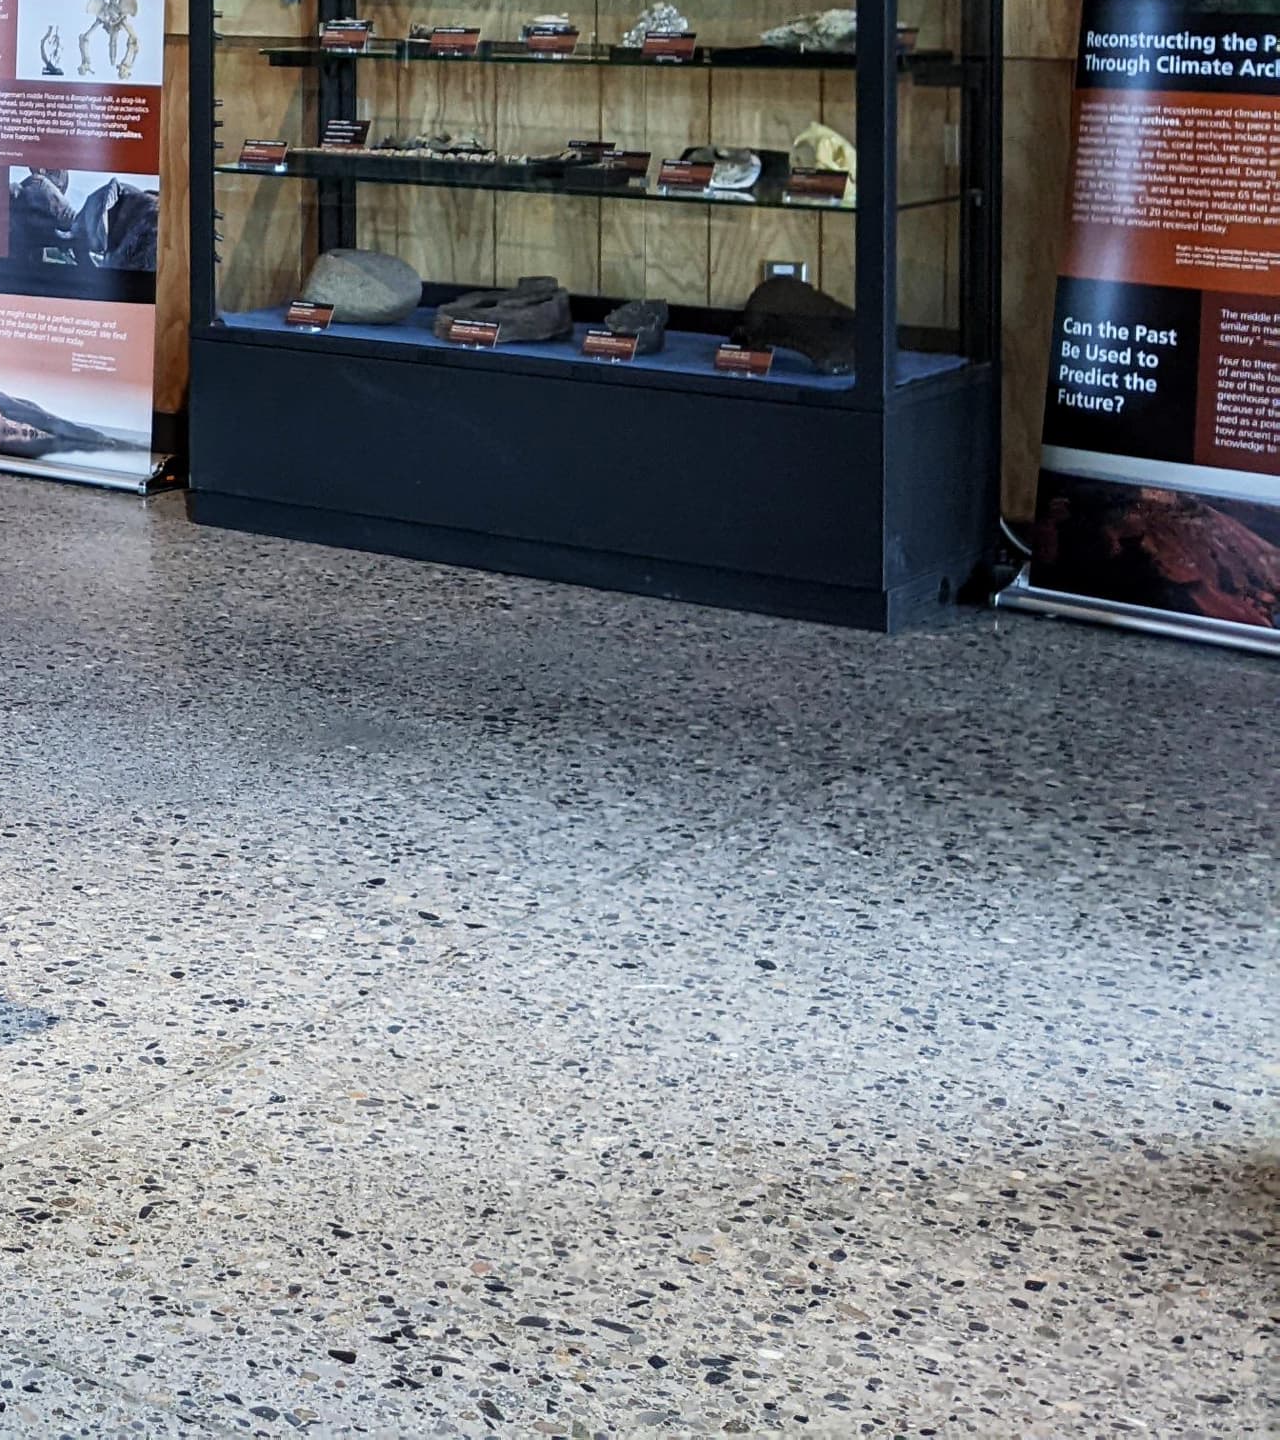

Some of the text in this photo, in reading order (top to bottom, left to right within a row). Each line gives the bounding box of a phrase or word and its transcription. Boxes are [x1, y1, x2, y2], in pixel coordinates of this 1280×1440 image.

[1087, 31, 1215, 54] Reconstructing
[1222, 32, 1257, 51] the
[1085, 53, 1150, 76] Through
[1157, 56, 1233, 75] Climate
[1164, 107, 1271, 119] ecosystems and climates
[1142, 117, 1181, 127] archives,
[1163, 129, 1267, 142] climate archives include
[1172, 141, 1192, 149] coral
[1223, 144, 1239, 152] tree
[1157, 151, 1267, 165] from middle Pliocene
[1169, 164, 1276, 179] million years During
[1180, 176, 1237, 187] temperatures
[1187, 187, 1210, 197] levels
[1139, 195, 1246, 211] Climate archives indicate
[1150, 208, 1261, 224] 20 inches of precipitation
[1127, 217, 1198, 231] amount received
[1222, 308, 1271, 322] The middle
[1063, 317, 1177, 345] Can the Past
[1221, 322, 1249, 332] similar
[1062, 341, 1159, 368] Be Used to
[1219, 355, 1278, 370] Four to three
[1059, 365, 1157, 392] Predict the
[1219, 367, 1265, 381] of animals
[1218, 380, 1264, 392] size the
[1058, 389, 1124, 413] Future?
[1218, 391, 1269, 405] greenhouse
[1217, 402, 1253, 414] Because
[1217, 414, 1238, 424] used
[1216, 425, 1270, 440] how ancient
[1215, 436, 1264, 452] knowledge
